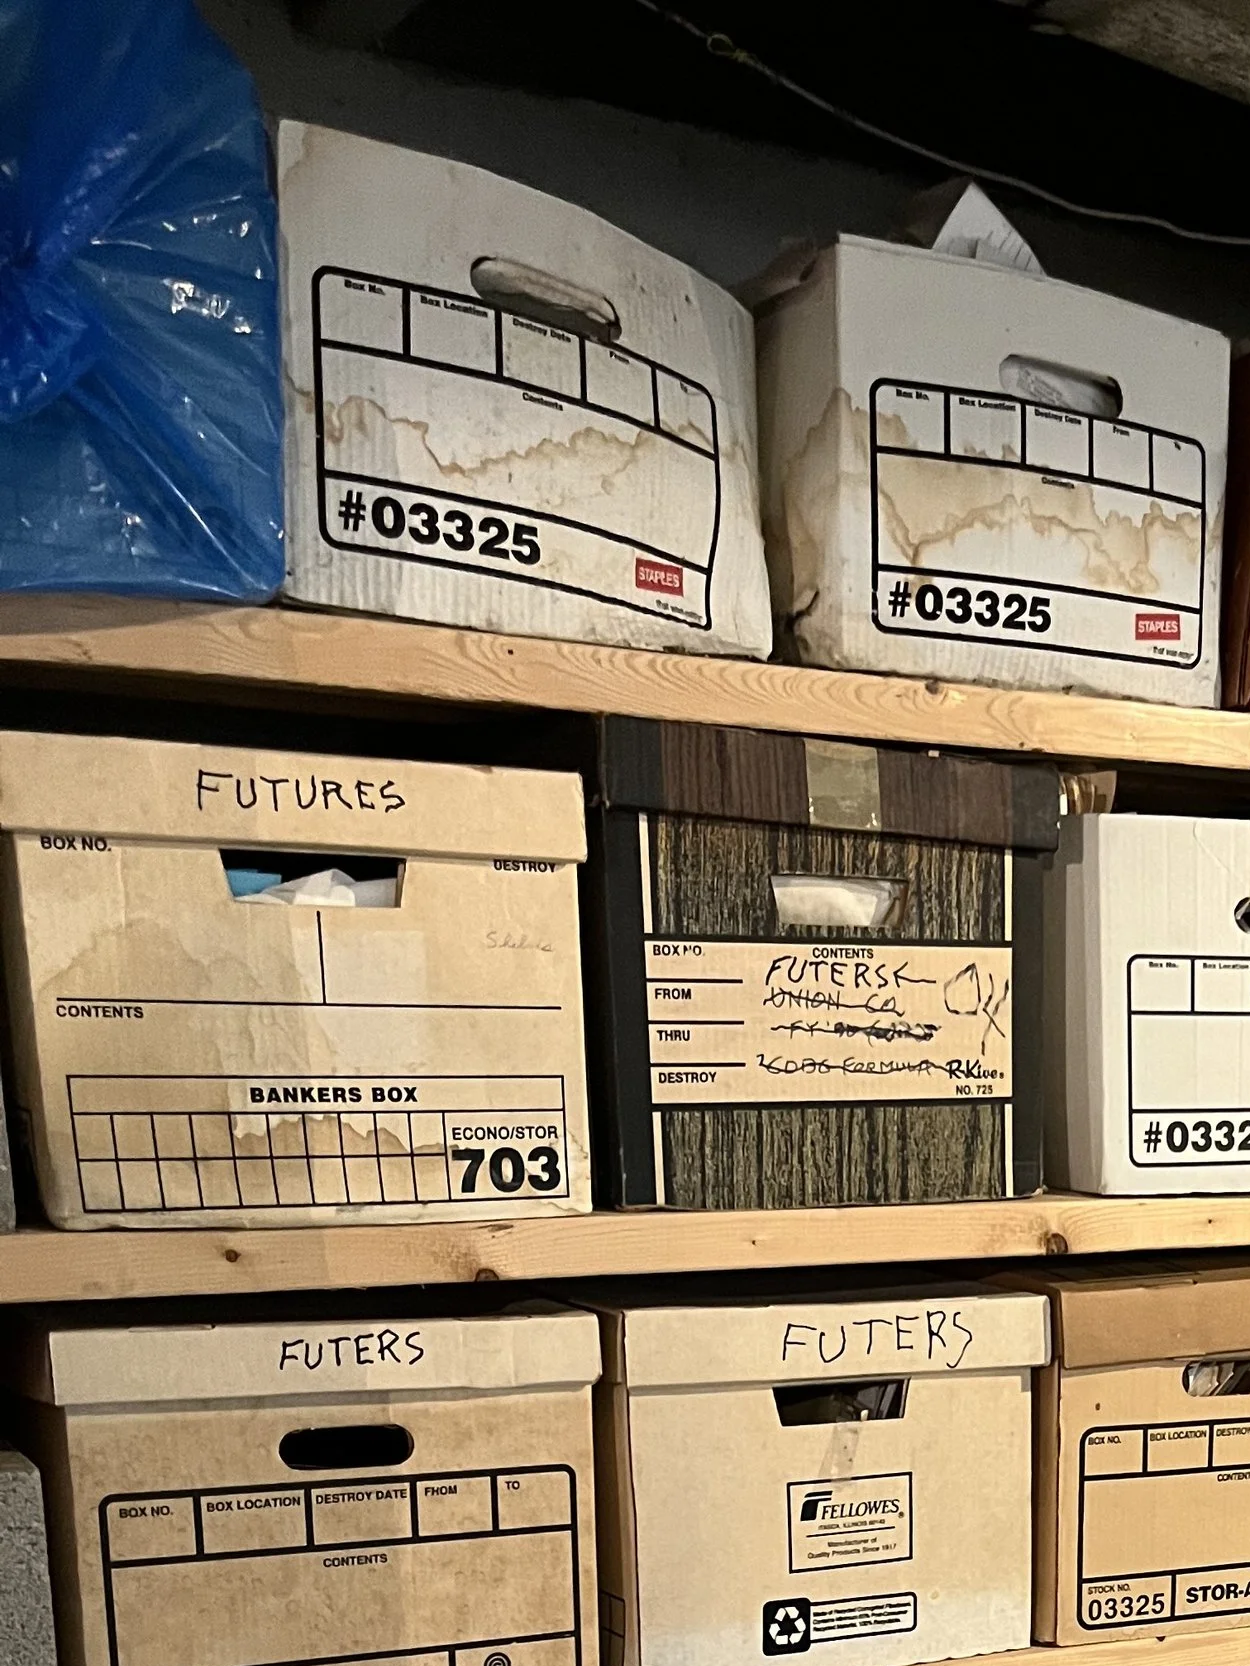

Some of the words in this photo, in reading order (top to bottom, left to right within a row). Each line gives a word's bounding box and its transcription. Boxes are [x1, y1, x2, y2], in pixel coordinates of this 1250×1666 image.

[338, 489, 542, 565] #03325
[639, 567, 679, 587] STAPLES
[889, 581, 1051, 633] #03325
[1138, 618, 1178, 632] STAPLES
[197, 768, 405, 813] FUTURES
[41, 836, 77, 851] BOX
[82, 837, 113, 852] NO.
[494, 859, 556, 872] DESTROY
[812, 948, 873, 958] CONTENTS
[766, 956, 889, 988] FUTERS
[655, 988, 691, 1000] FROM
[55, 1004, 143, 1019] CONTENTS
[657, 1030, 690, 1041] THRU
[250, 1087, 362, 1103] BANKERS
[372, 1087, 417, 1103] BOX
[451, 1125, 558, 1140] ECONO/STOR
[451, 1146, 561, 1193] 703
[782, 1311, 972, 1368] FUTERS
[279, 1330, 424, 1370] FUTERS
[1150, 1433, 1166, 1441] BOX
[1168, 1429, 1207, 1440] LOCATION
[315, 1491, 372, 1505] DESTROY
[376, 1488, 407, 1501] DATE
[424, 1484, 457, 1496] FROM
[206, 1500, 233, 1513] BOX
[237, 1496, 301, 1510] LOCATION
[822, 1499, 900, 1519] FELLOWES
[808, 1551, 829, 1559] Quality
[832, 1548, 860, 1556] Products
[1088, 1594, 1165, 1621] 03325
